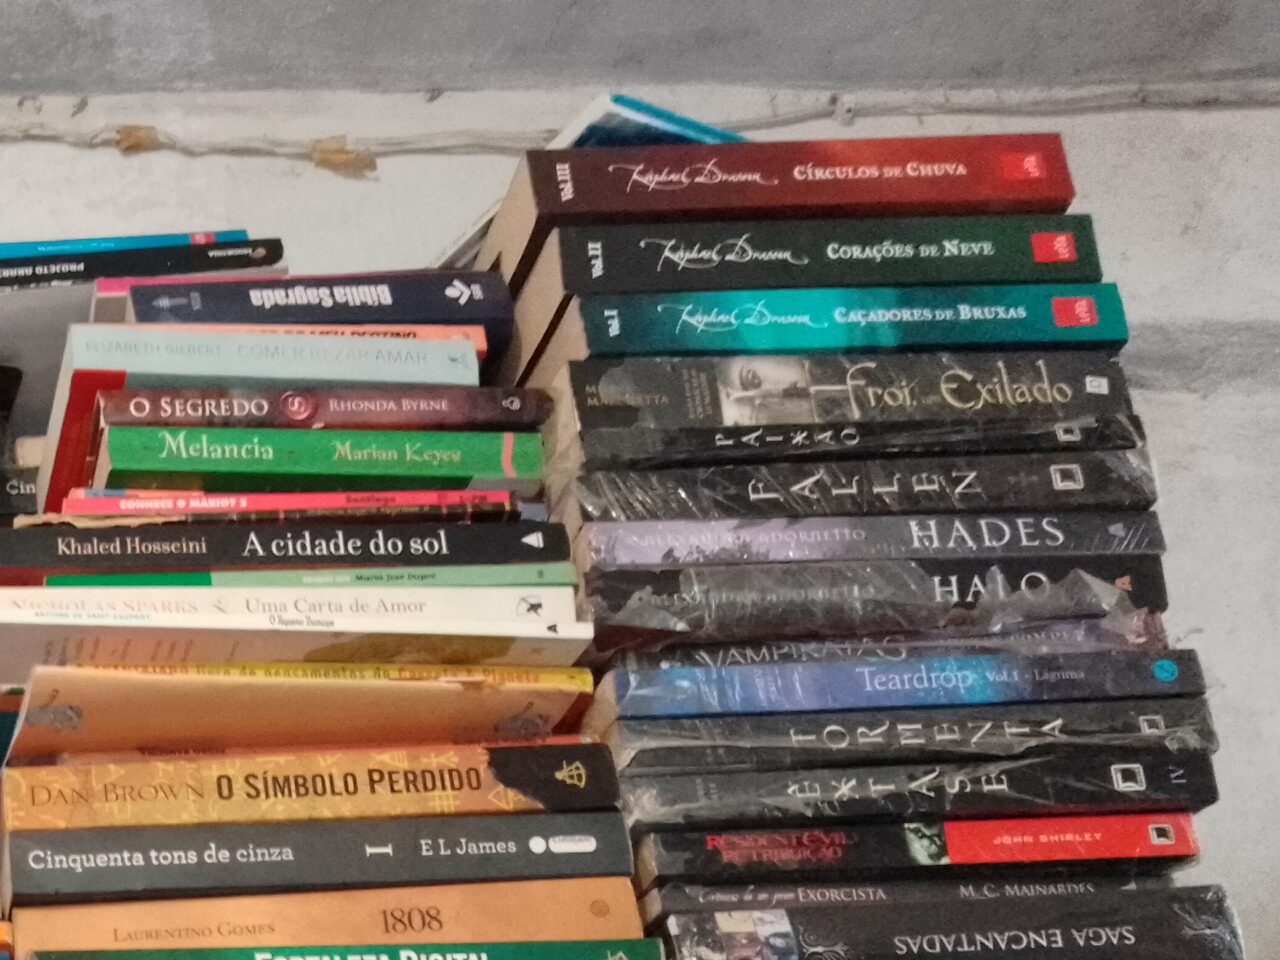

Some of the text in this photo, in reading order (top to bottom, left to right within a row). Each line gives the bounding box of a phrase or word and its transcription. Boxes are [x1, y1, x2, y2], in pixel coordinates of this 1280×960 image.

[793, 160, 968, 181] CÍRCULOS DE CHUVA
[827, 238, 996, 263] CORAÇÕES DE NEVE
[249, 284, 333, 309] Sagrada
[833, 304, 933, 328] CAÇADORES
[958, 303, 1027, 320] BRUXAS
[237, 344, 304, 362] COMER
[375, 349, 429, 366] AMAR
[939, 359, 1073, 411] Exilado
[129, 395, 449, 418] O SEGREDO RHONDA BYRNE
[158, 430, 462, 466] Melancia Marian Keyes
[57, 530, 451, 557] Khaled Hosseini A cidade do sol
[908, 516, 1066, 550] HADES
[246, 598, 427, 615] Uma Carta de Amor
[855, 664, 974, 691] Teardrop
[30, 766, 483, 807] DAN BROWN O SÍMBOLO PERDIDO
[28, 841, 294, 873] Cinquenta tons de cinza
[420, 837, 517, 857] E L James
[798, 886, 888, 903] EXORCISTA
[113, 921, 277, 943] LAURENTINO GOMES
[381, 905, 444, 934] 1808
[894, 925, 1137, 956] SAGA ENCANTADAS
